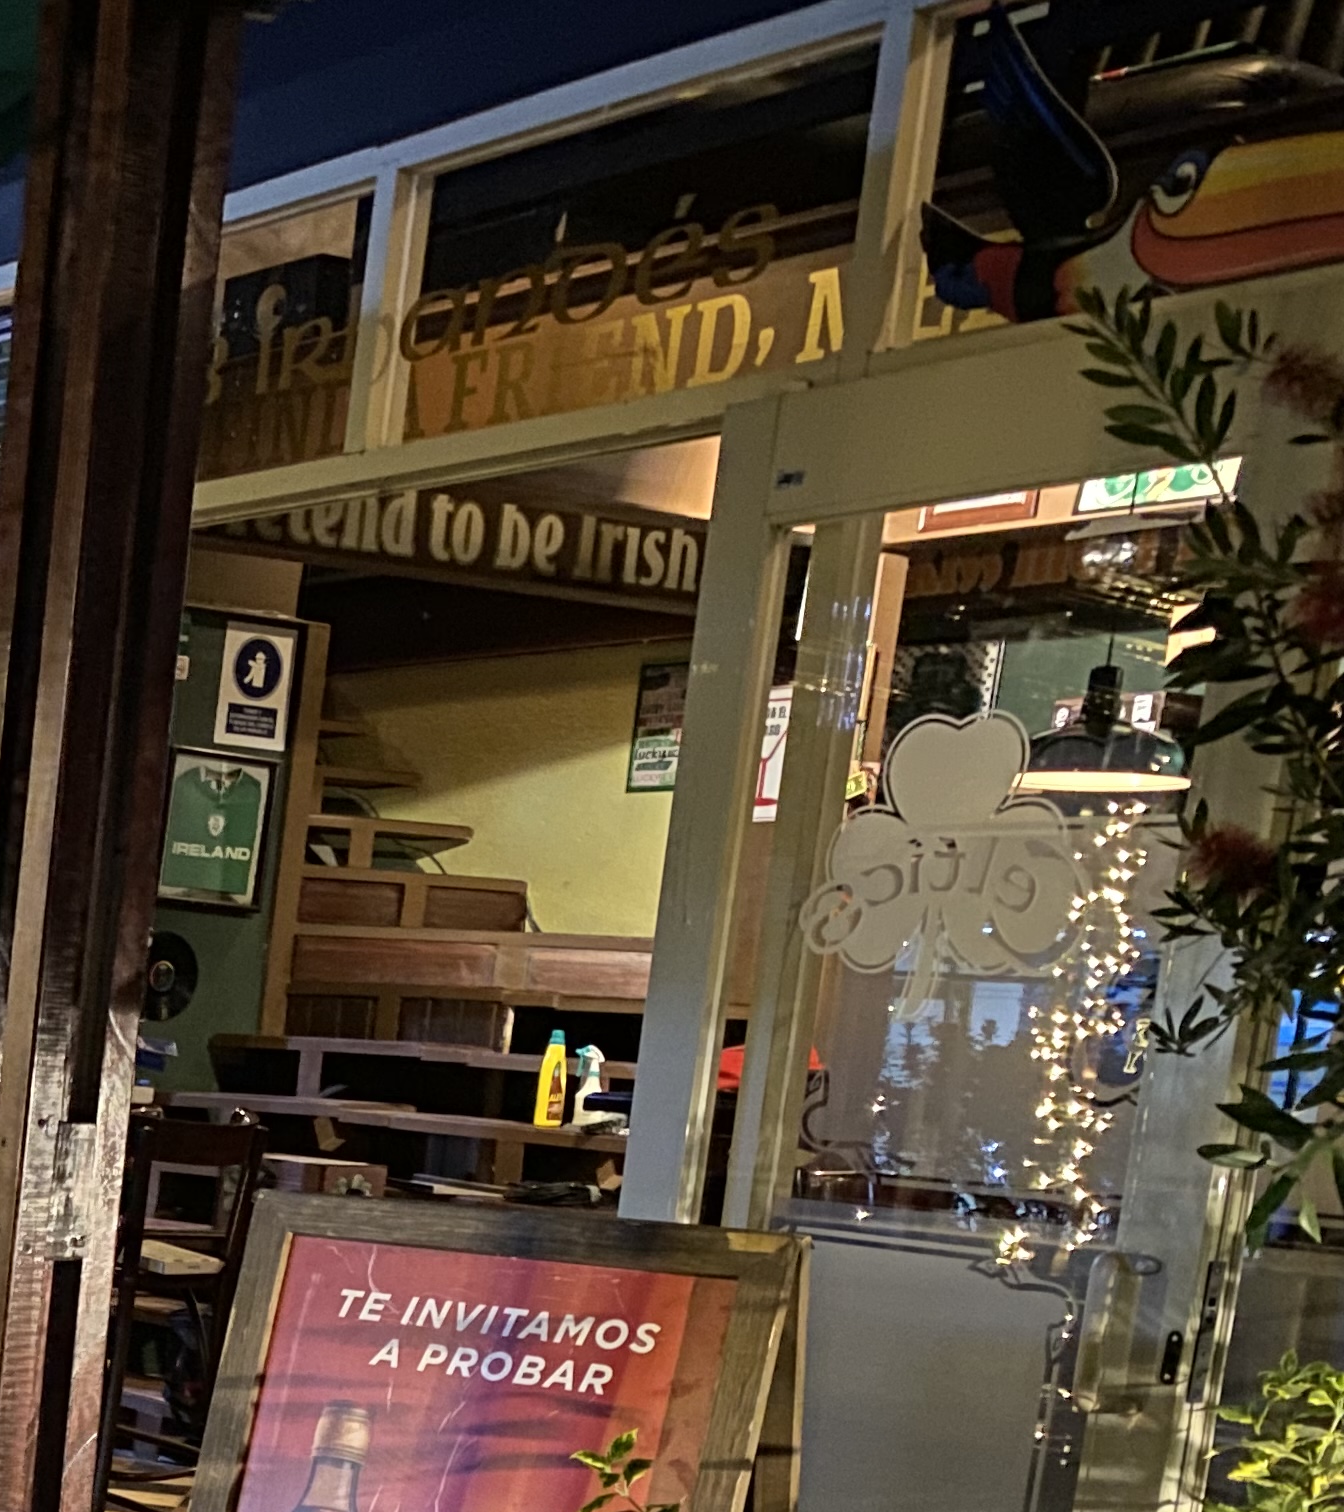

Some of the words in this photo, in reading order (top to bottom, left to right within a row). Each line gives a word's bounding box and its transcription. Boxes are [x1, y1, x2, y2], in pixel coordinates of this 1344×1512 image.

[430, 493, 485, 566] to
[495, 503, 566, 578] be
[572, 515, 699, 592] Irish
[172, 841, 251, 862] IRELAND
[338, 1289, 392, 1322] TE
[400, 1296, 661, 1355] INVITAMOS
[368, 1338, 400, 1369] A
[416, 1343, 614, 1395] PROBAR
